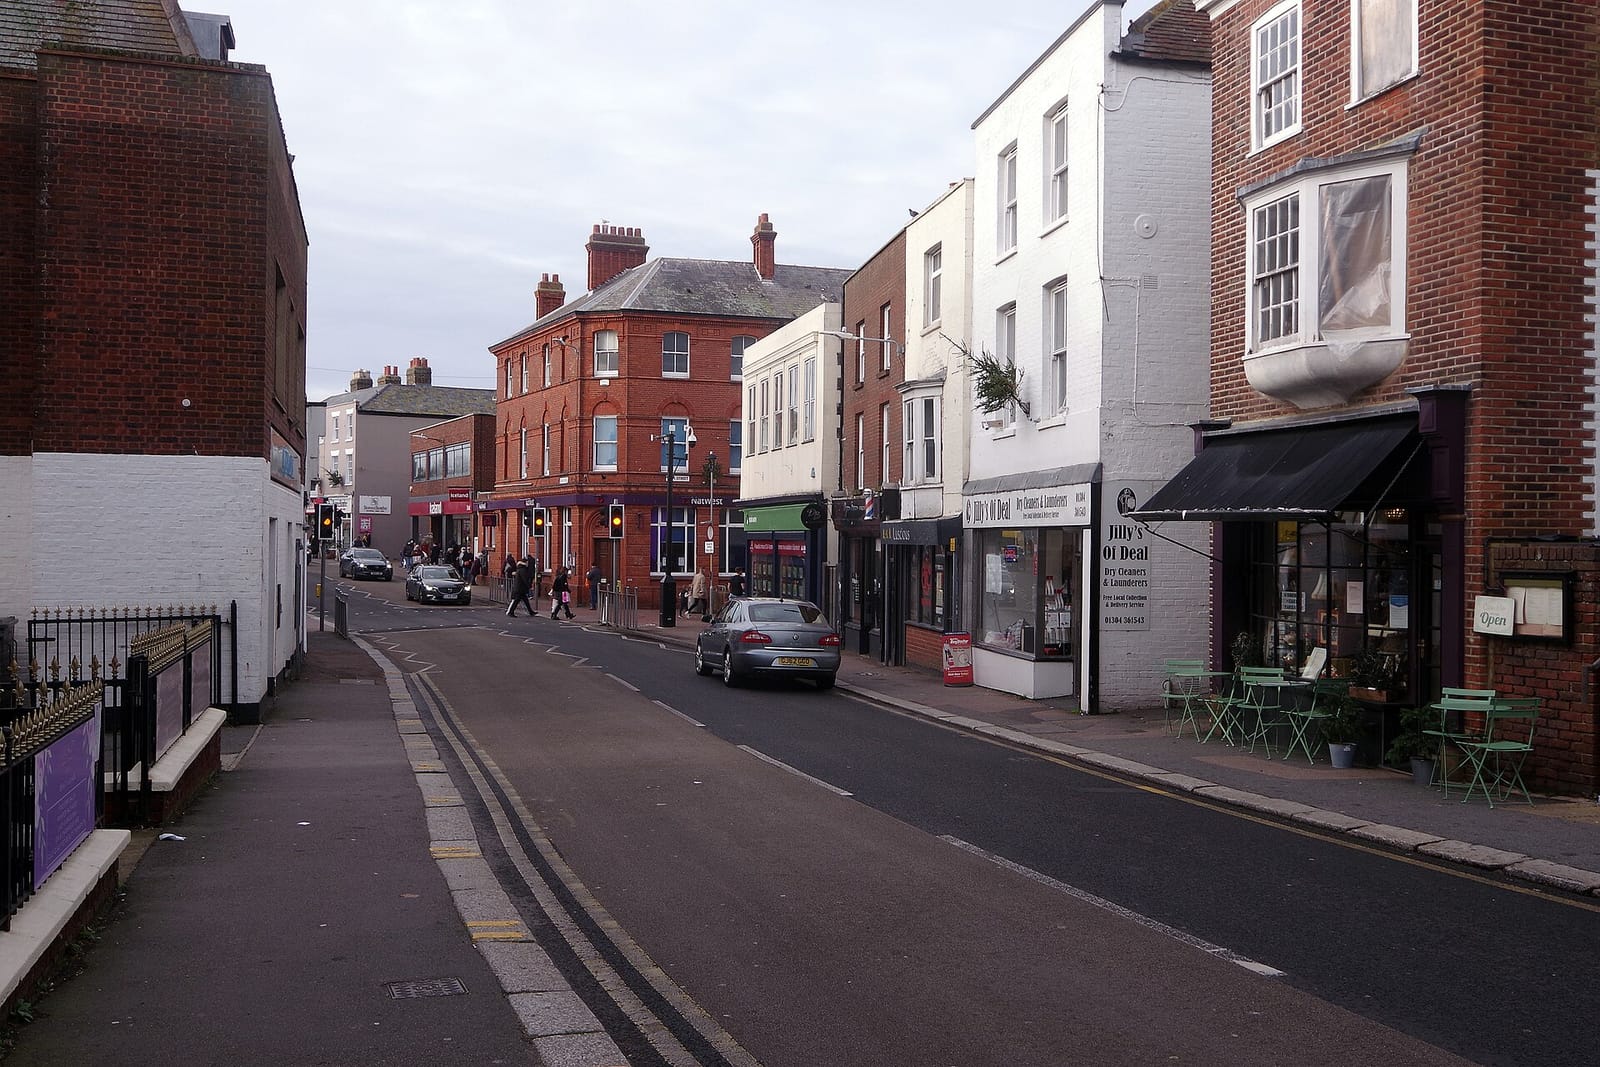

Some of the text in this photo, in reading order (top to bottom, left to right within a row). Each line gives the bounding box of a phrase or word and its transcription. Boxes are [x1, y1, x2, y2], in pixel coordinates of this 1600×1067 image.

[690, 498, 723, 506] NatWest
[1024, 496, 1040, 509] Cleaners
[1044, 494, 1068, 508] Launderers
[973, 500, 989, 524] Jilly's
[997, 498, 1012, 521] Deal
[1108, 525, 1143, 541] Jilly's
[1103, 545, 1148, 561] Of Deal
[1104, 567, 1147, 577] Dry Cleaners
[1103, 578, 1148, 587] & Launderers
[1110, 601, 1128, 609] Delivery
[1104, 616, 1145, 624] 01304 361543
[1480, 611, 1507, 628] Open
